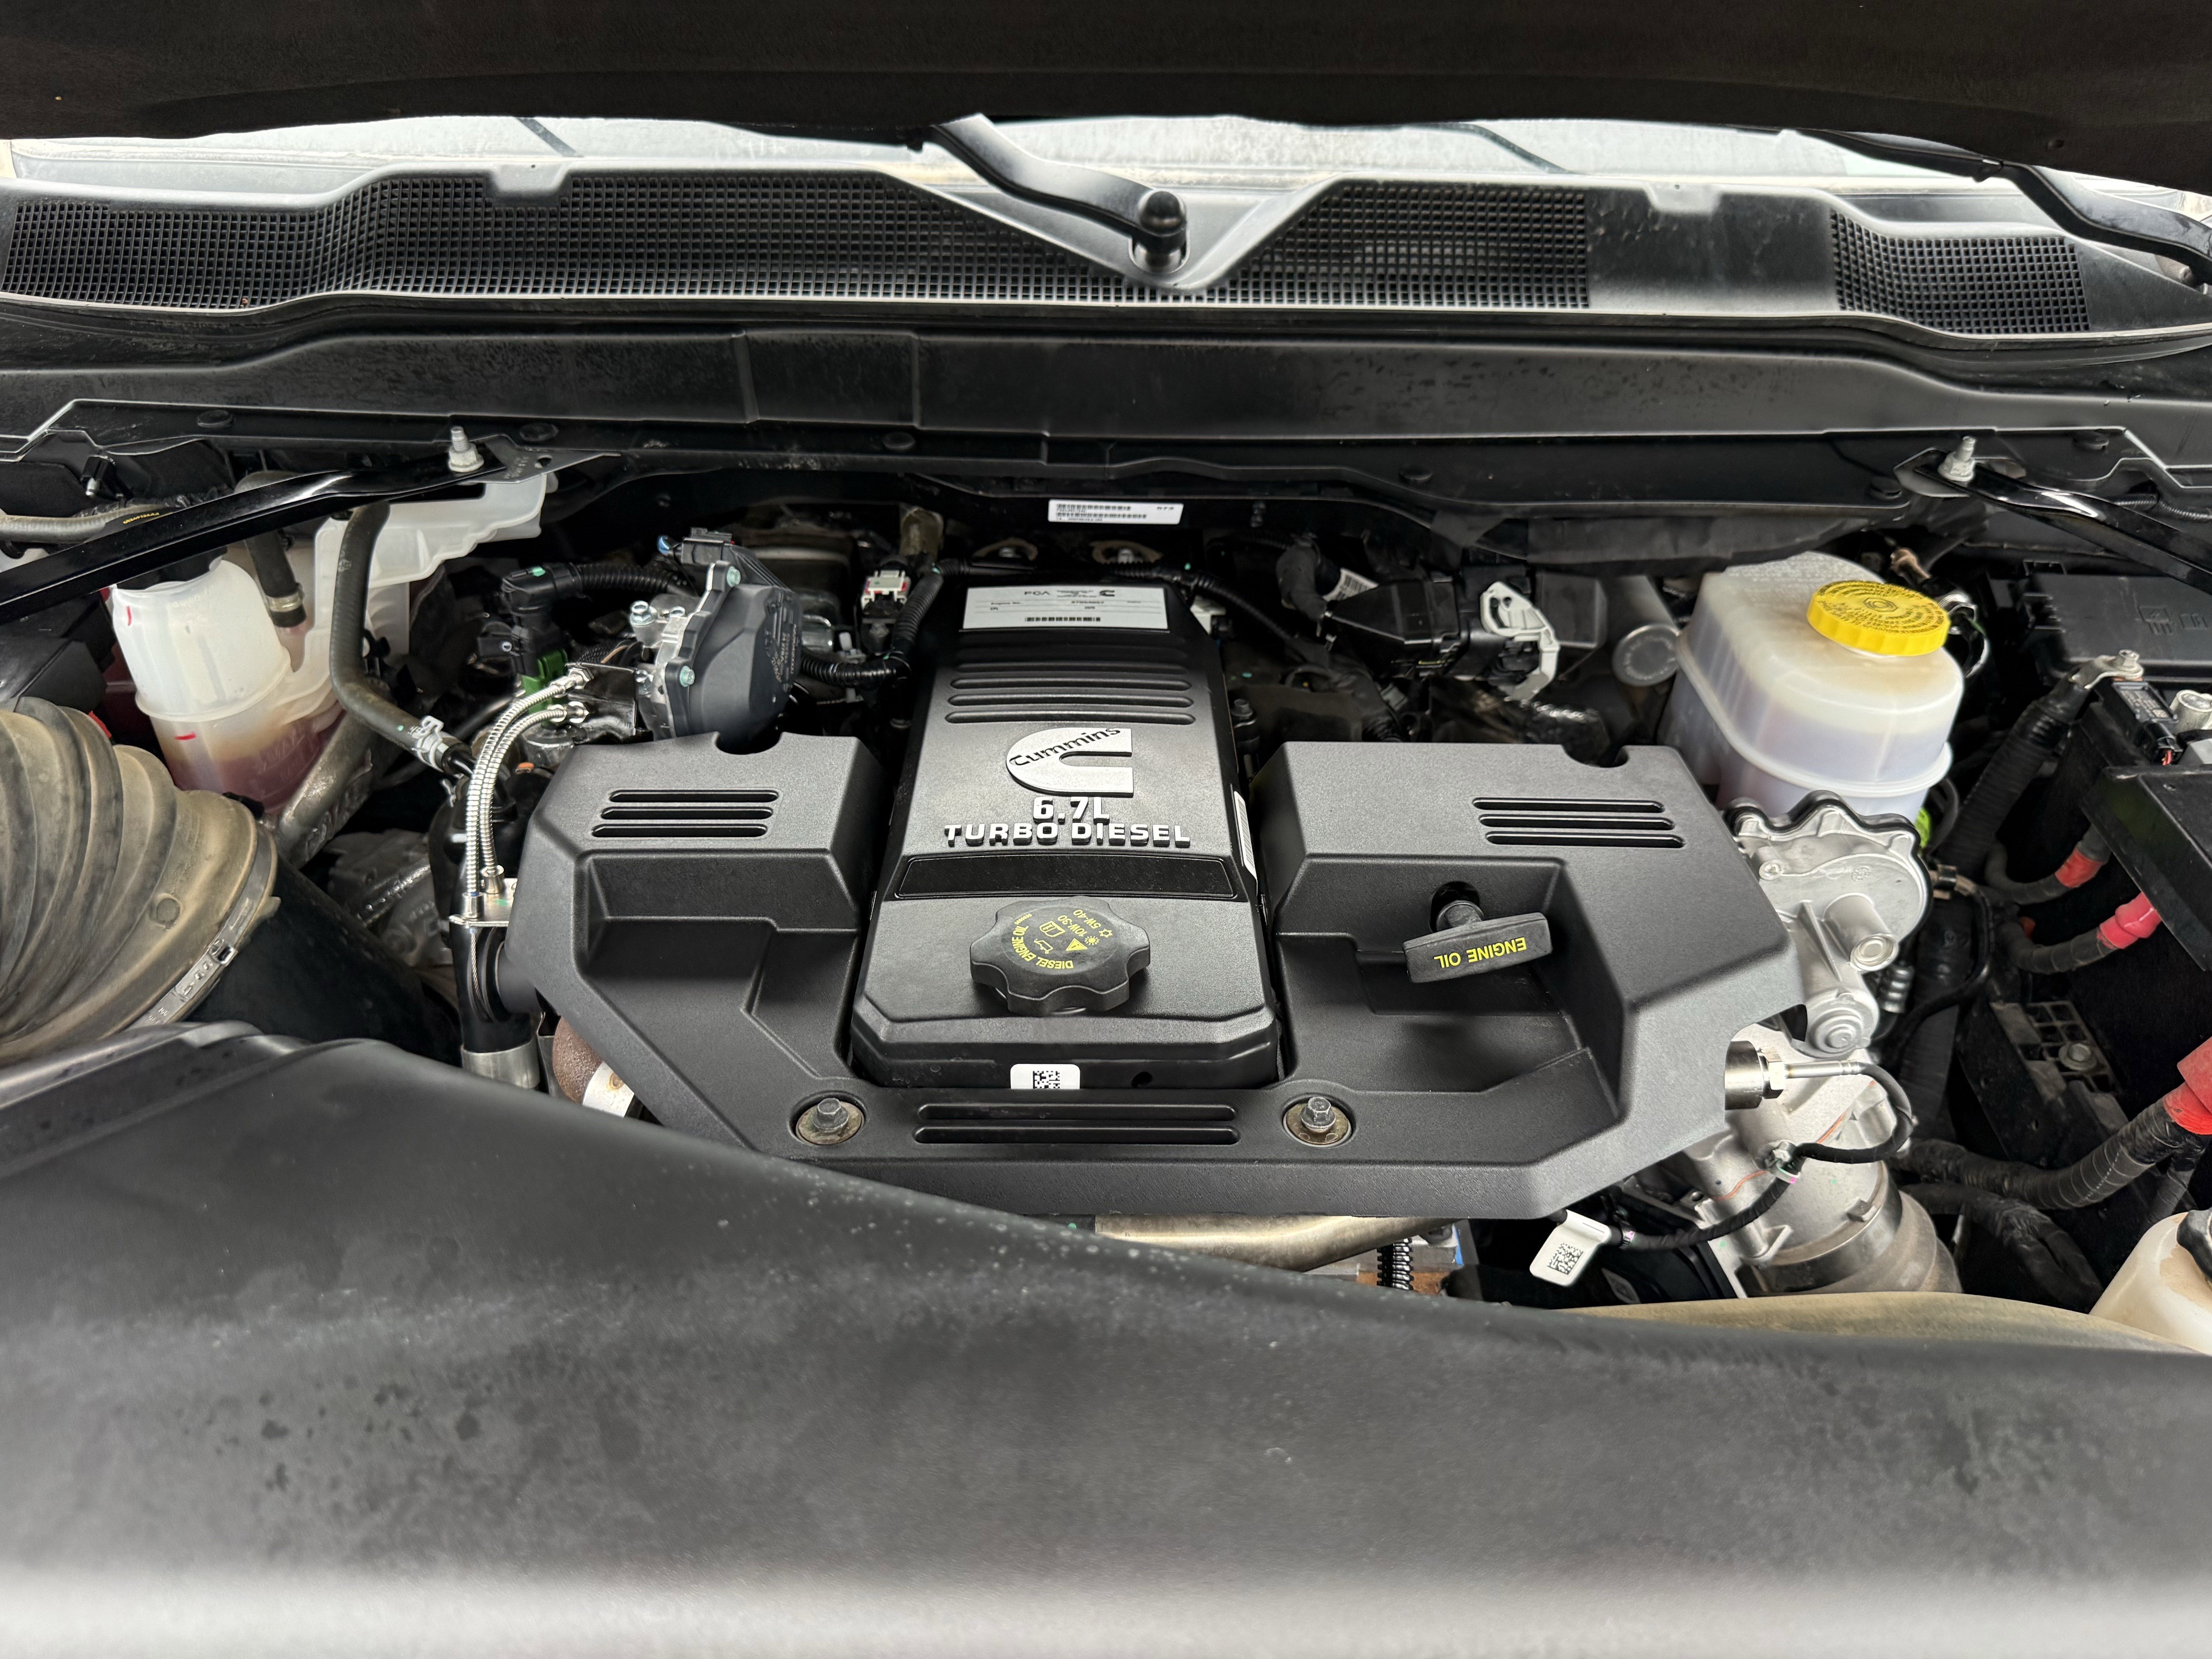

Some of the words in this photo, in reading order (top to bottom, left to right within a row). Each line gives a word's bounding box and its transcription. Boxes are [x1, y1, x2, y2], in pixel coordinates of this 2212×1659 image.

[1009, 728, 1121, 766] Cummins
[1033, 796, 1110, 823] 6.7L
[944, 823, 1058, 847] TURBO
[1071, 822, 1190, 847] DIESEL
[1012, 925, 1029, 936] OIL
[1057, 915, 1087, 937] 10W-30
[1073, 909, 1102, 929] 5W-40
[1012, 936, 1037, 962] ENGINE
[1434, 952, 1461, 968] OIL
[1466, 937, 1527, 963] ENGINE
[1036, 956, 1074, 969] DIESEL
